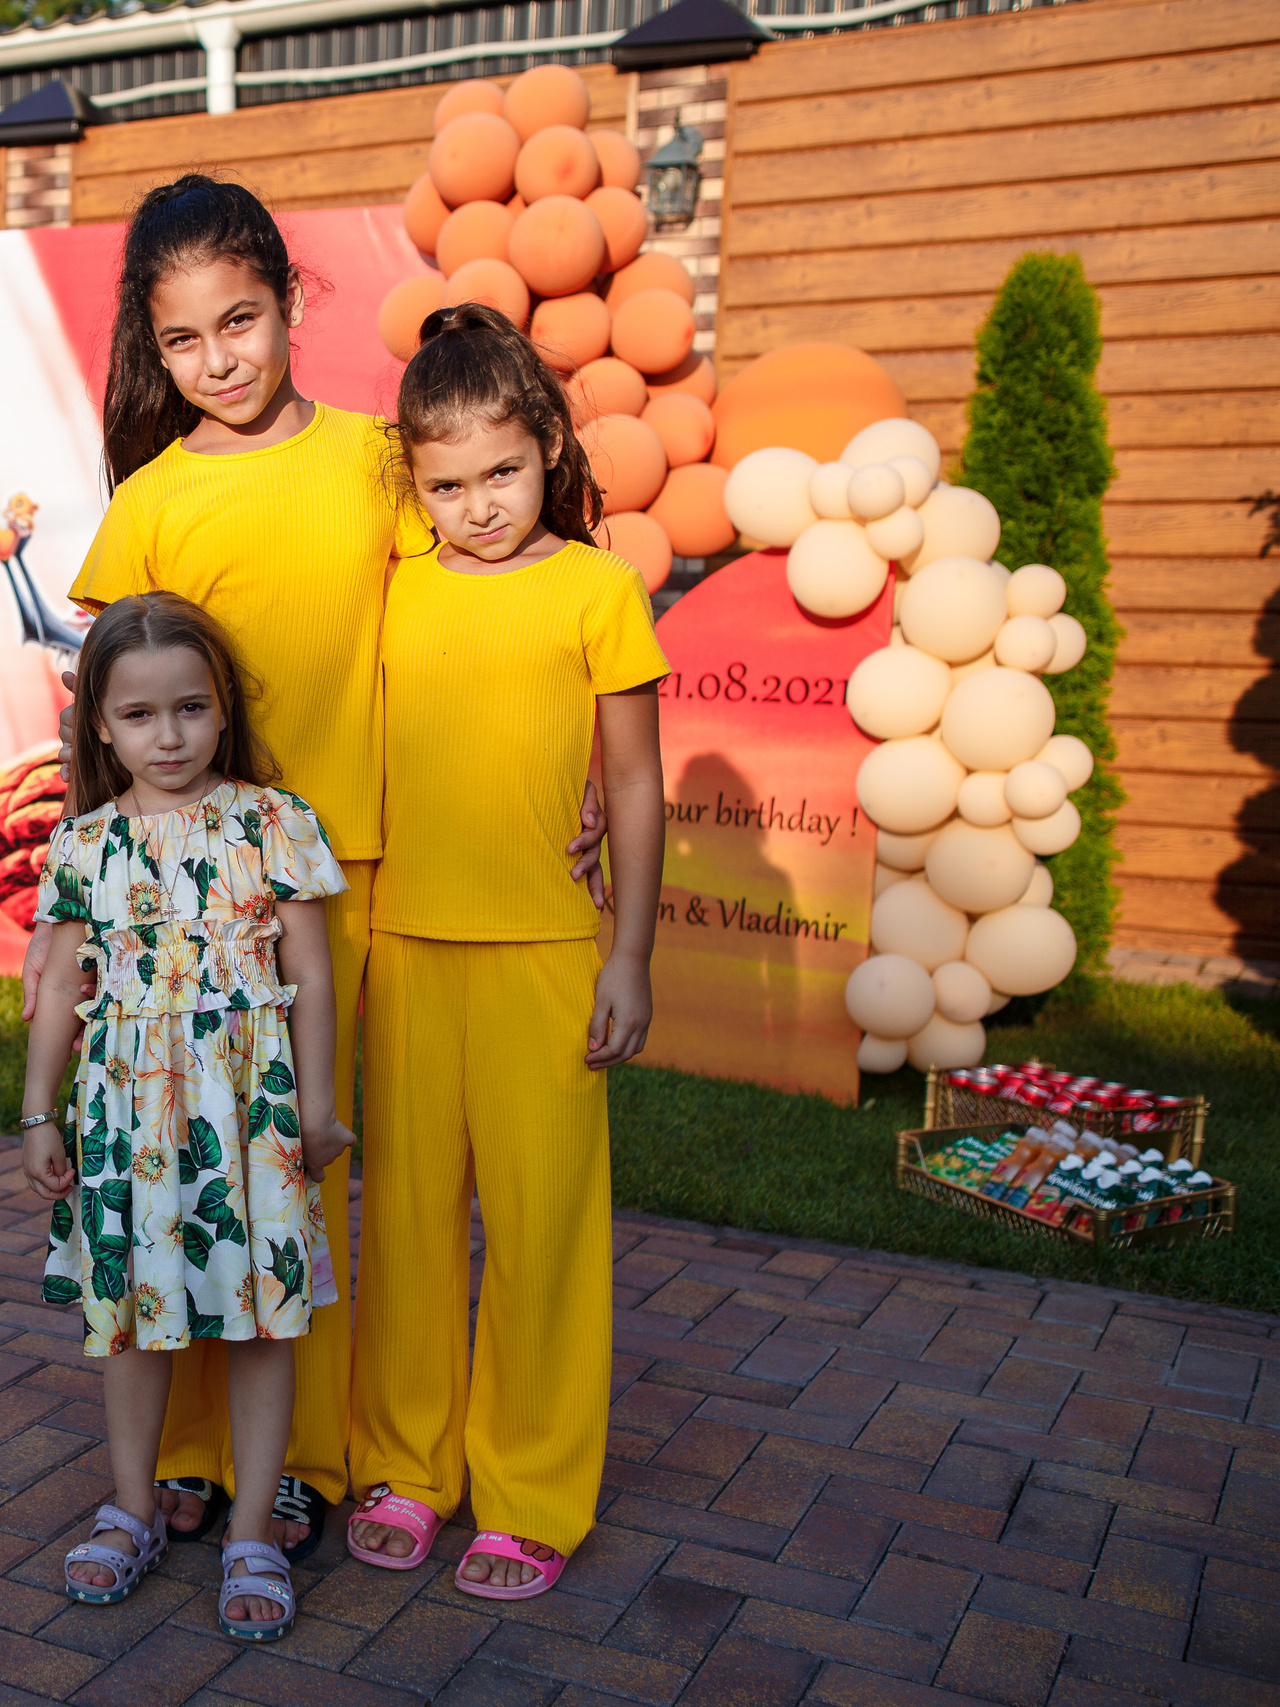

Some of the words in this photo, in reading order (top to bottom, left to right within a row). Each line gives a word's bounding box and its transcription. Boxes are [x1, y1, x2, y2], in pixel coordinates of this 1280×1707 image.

[664, 802, 709, 823] our
[716, 791, 840, 846] birthday
[686, 895, 710, 927] &
[717, 898, 847, 942] Vladimir
[384, 1503, 400, 1512] My
[388, 1496, 415, 1509] Hello
